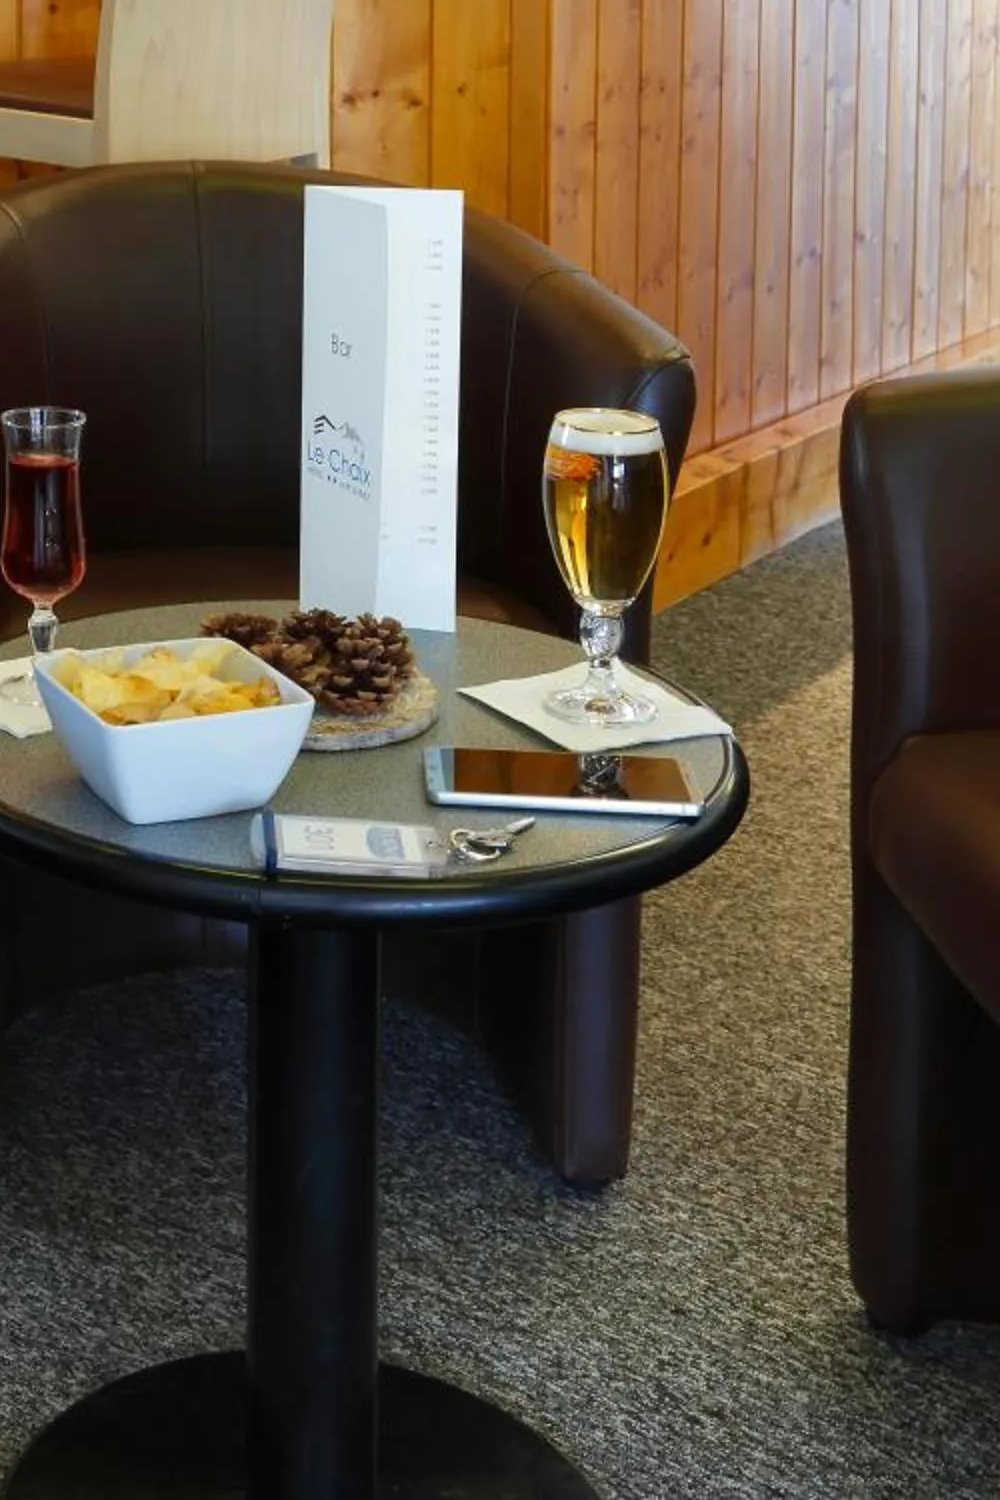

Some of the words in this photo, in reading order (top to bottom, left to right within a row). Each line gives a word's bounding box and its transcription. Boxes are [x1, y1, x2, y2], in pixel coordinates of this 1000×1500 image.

[330, 333, 353, 358] Bar
[307, 439, 325, 465] Le
[328, 449, 371, 485] Chaix
